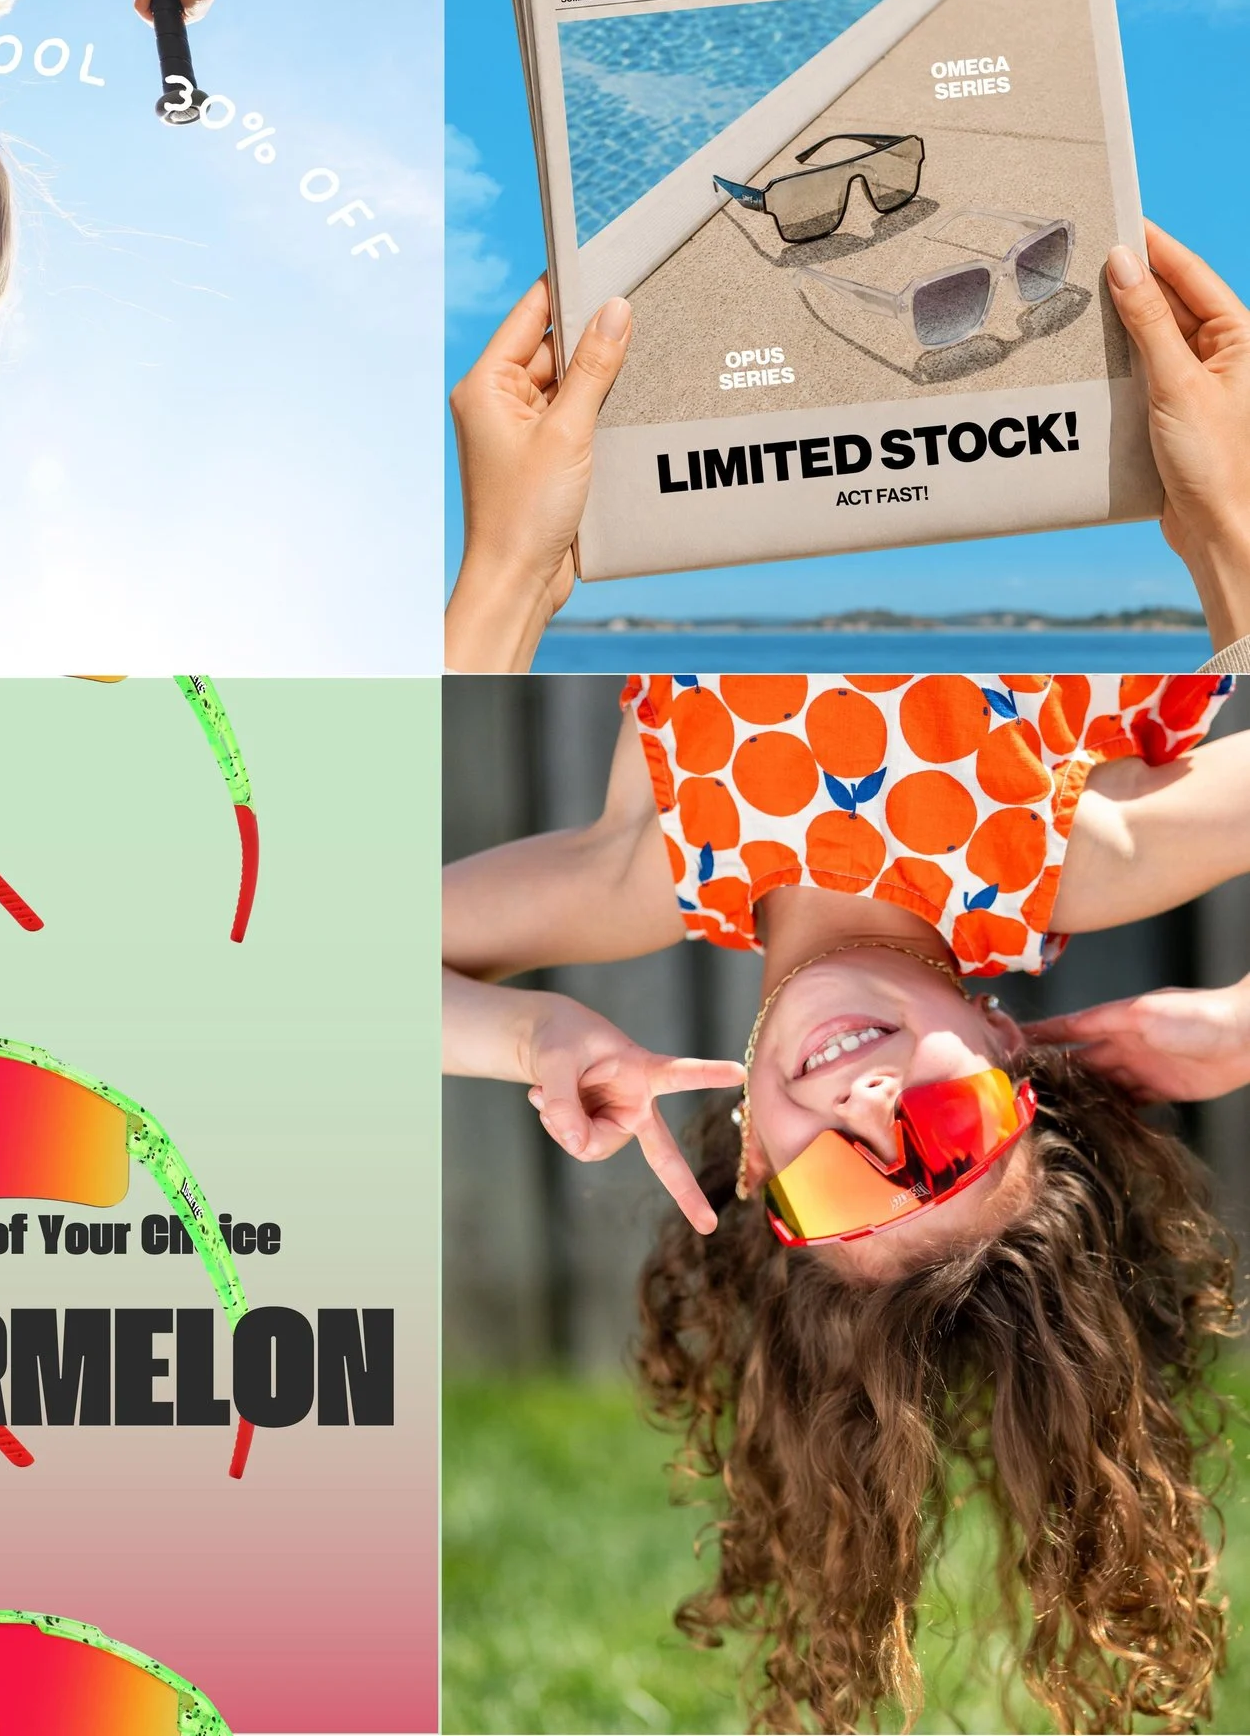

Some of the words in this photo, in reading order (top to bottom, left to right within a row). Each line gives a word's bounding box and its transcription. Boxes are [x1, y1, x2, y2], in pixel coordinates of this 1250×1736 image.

[930, 55, 1011, 79] OMEGA
[934, 76, 1011, 100] SERIES
[725, 346, 785, 368] OPUS
[719, 366, 795, 390] SERIES
[656, 433, 872, 494] LIMITED
[880, 411, 1080, 470] STOCK!
[836, 489, 872, 507] ACT
[876, 485, 929, 504] FAST!
